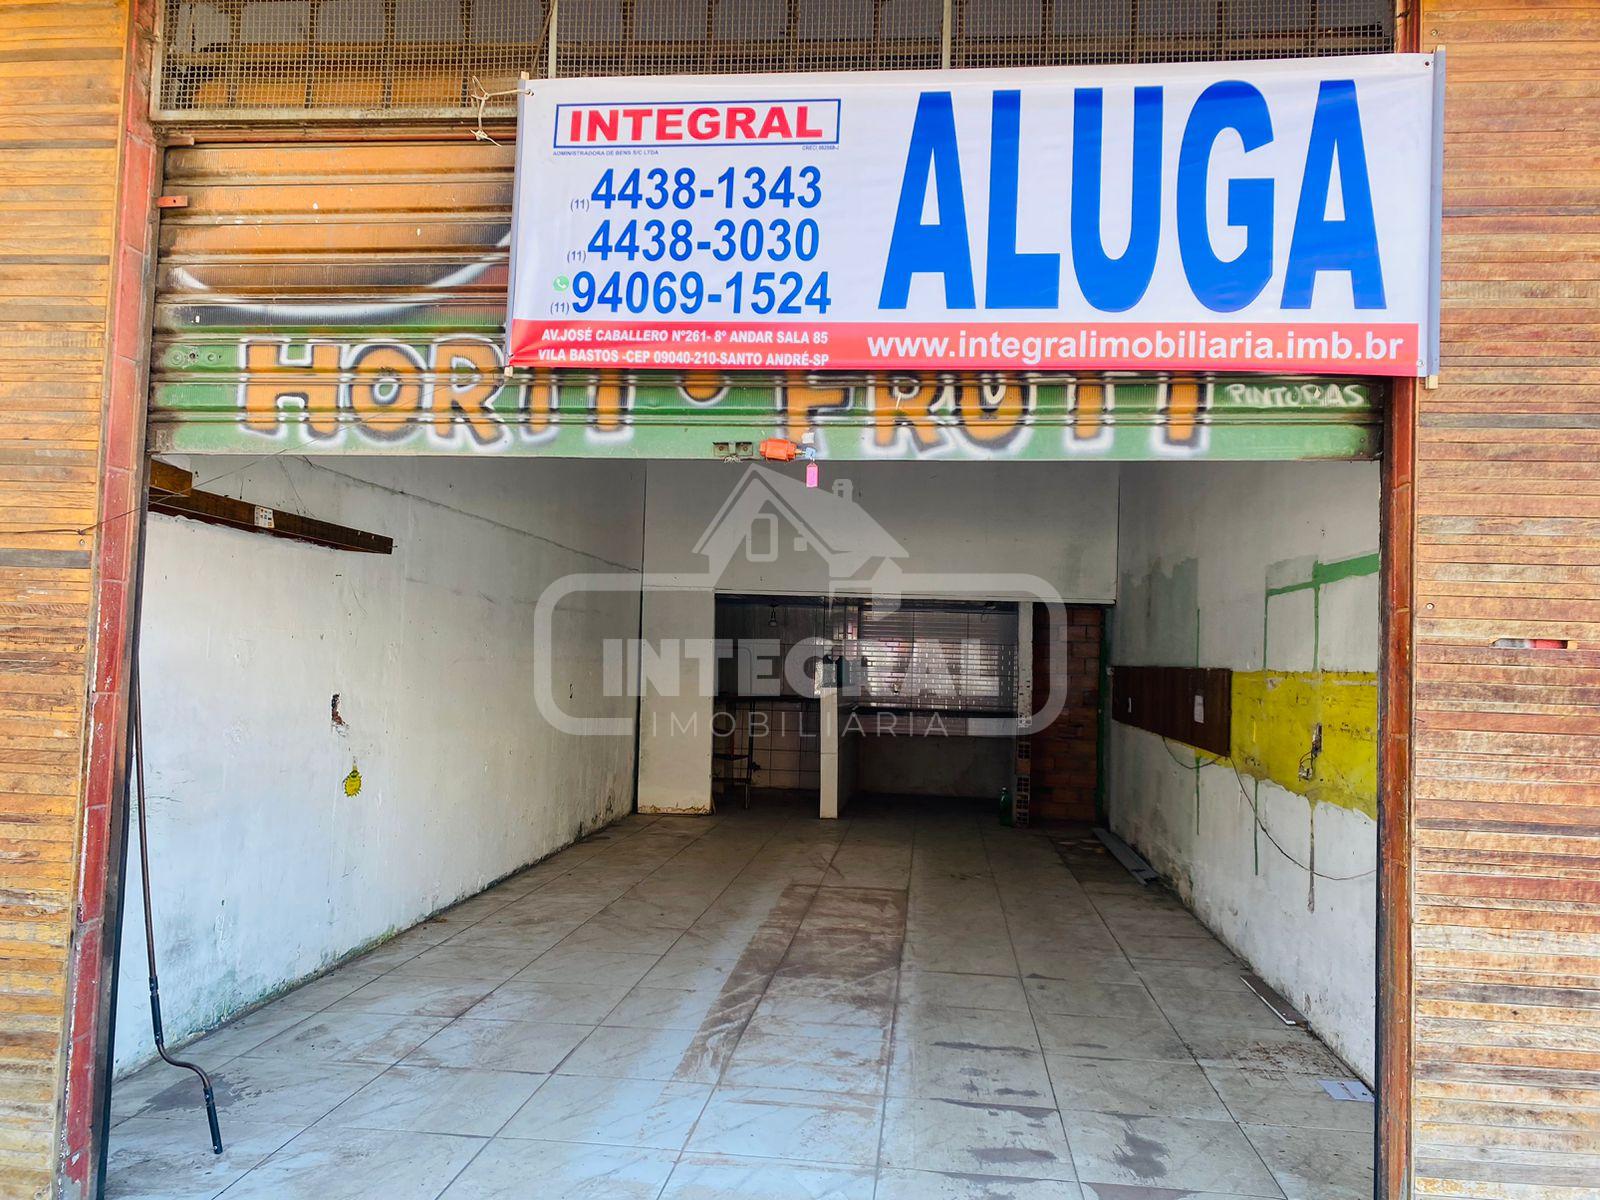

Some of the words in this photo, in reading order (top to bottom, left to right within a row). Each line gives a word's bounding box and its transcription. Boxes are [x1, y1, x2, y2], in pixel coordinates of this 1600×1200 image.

[570, 106, 823, 142] INTEGRAL
[570, 199, 590, 213] (11)
[591, 166, 822, 209] 4438-1343
[878, 79, 1387, 313] ALUGA
[567, 250, 587, 263] (11)
[588, 217, 819, 262] 4438-3030
[550, 301, 570, 315] (11)
[572, 271, 832, 314] 94069-1524
[595, 330, 669, 342] CABALLERO
[729, 331, 773, 344] ANDAR
[777, 331, 810, 344] SALA
[813, 332, 829, 344] 85
[867, 330, 1404, 365] www.integralimobiliaria.imb.br
[538, 349, 567, 361] VILA
[569, 349, 620, 362] BASTOS
[1225, 383, 1365, 407] PINTURAS
